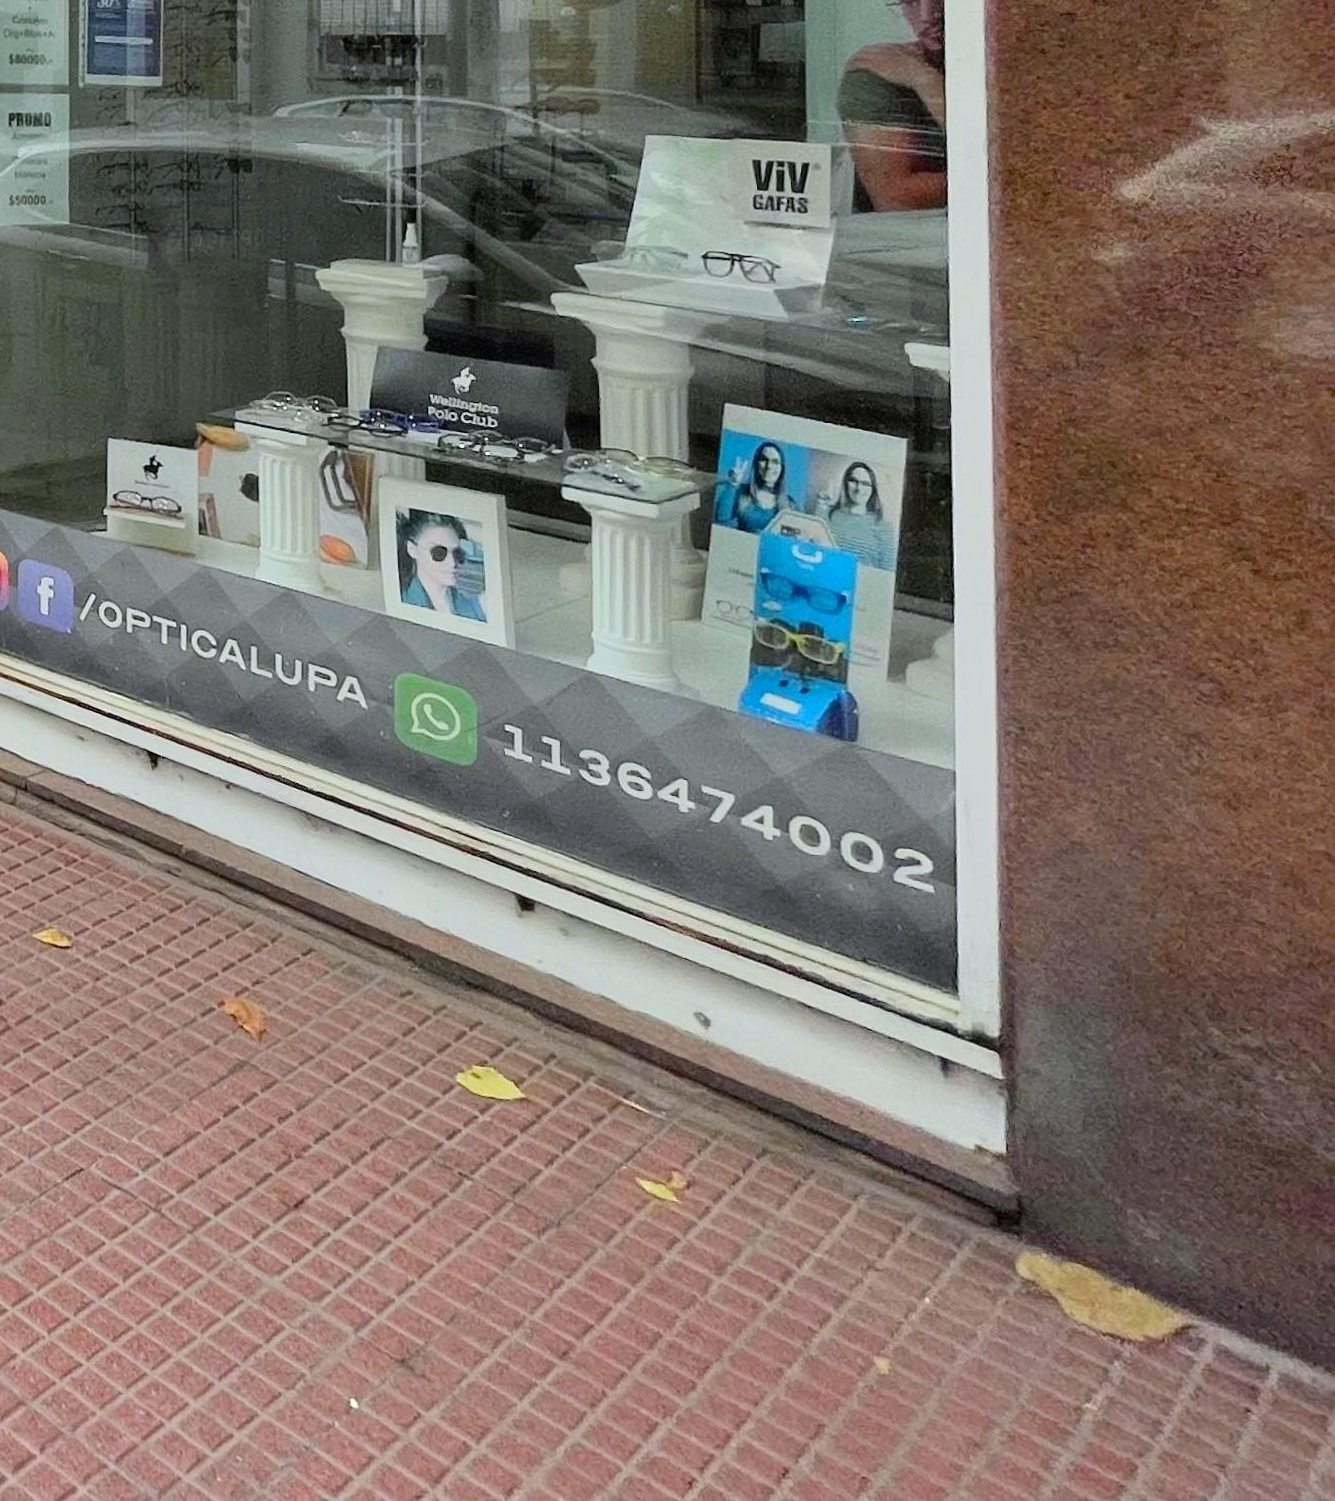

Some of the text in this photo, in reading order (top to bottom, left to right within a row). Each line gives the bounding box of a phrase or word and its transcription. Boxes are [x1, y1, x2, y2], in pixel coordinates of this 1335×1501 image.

[8, 112, 51, 127] PROMO
[753, 194, 808, 214] GAFAS
[429, 393, 499, 415] Wellington
[427, 405, 498, 428] Polo Club
[503, 724, 936, 895] 1136474002
